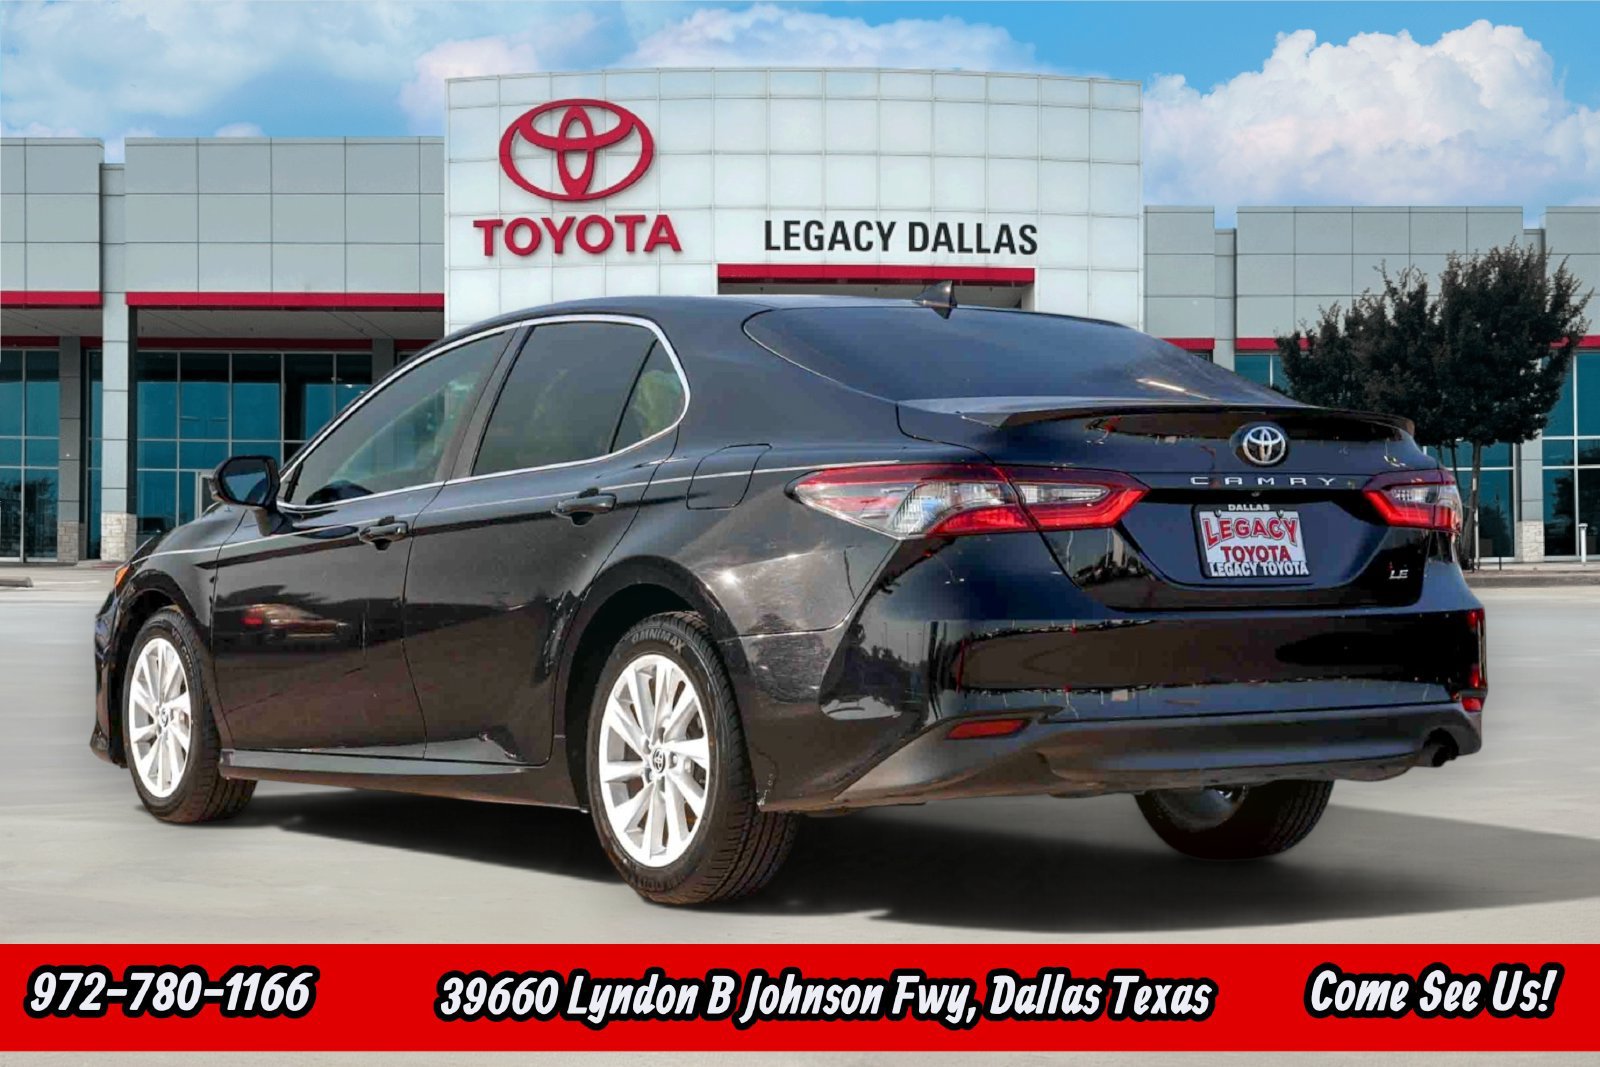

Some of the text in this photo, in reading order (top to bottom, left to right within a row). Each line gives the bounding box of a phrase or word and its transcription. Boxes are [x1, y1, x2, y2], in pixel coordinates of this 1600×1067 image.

[474, 214, 682, 256] TOYOTA
[765, 220, 1038, 255] LEGACY DALLAS
[1190, 476, 1337, 486] CAMRY
[1228, 504, 1270, 512] DALLAS
[1202, 518, 1299, 550] LEGACY
[1220, 545, 1292, 563] TOYOTA
[1209, 561, 1309, 577] LEGACY TOYOTA
[1389, 569, 1409, 580] LE
